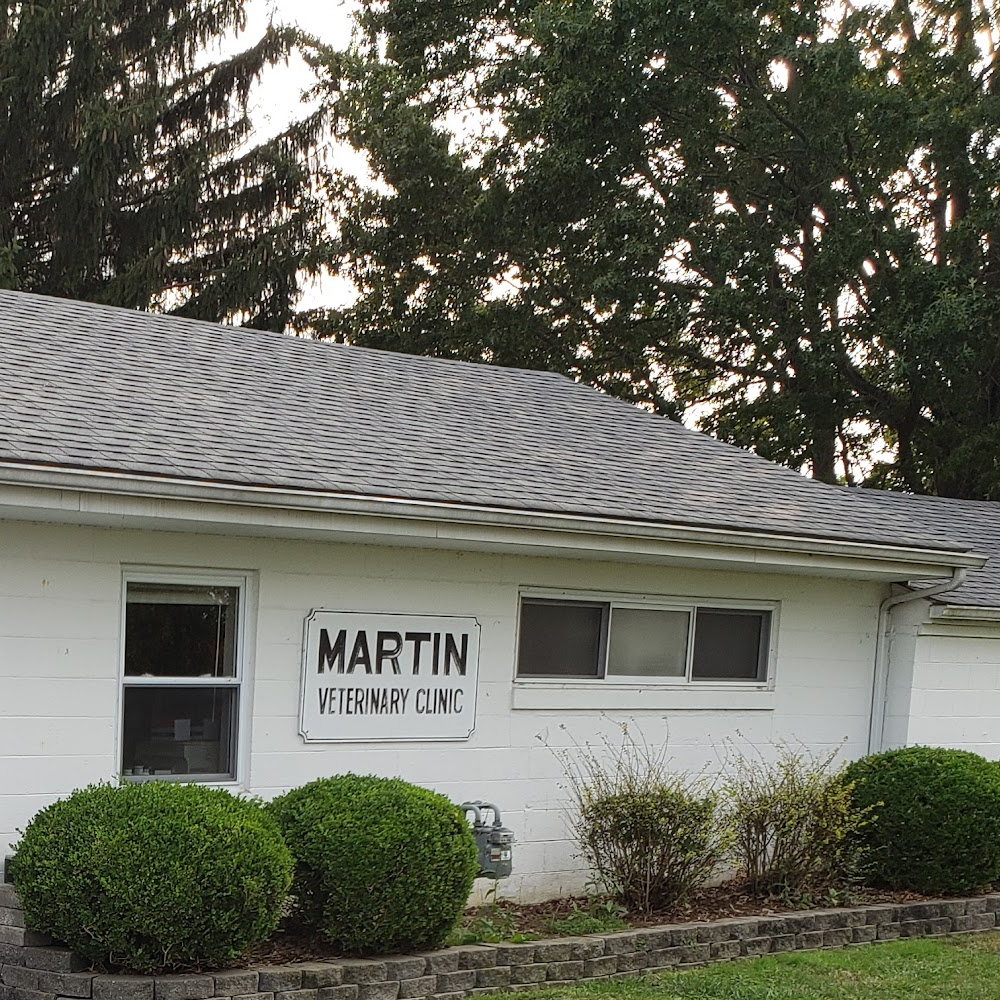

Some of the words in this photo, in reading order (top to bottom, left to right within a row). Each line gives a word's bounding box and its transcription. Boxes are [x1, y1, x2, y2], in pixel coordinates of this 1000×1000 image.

[317, 628, 469, 676] MARTIN
[318, 687, 410, 715] VETERINARY
[415, 688, 464, 714] CLINIC
